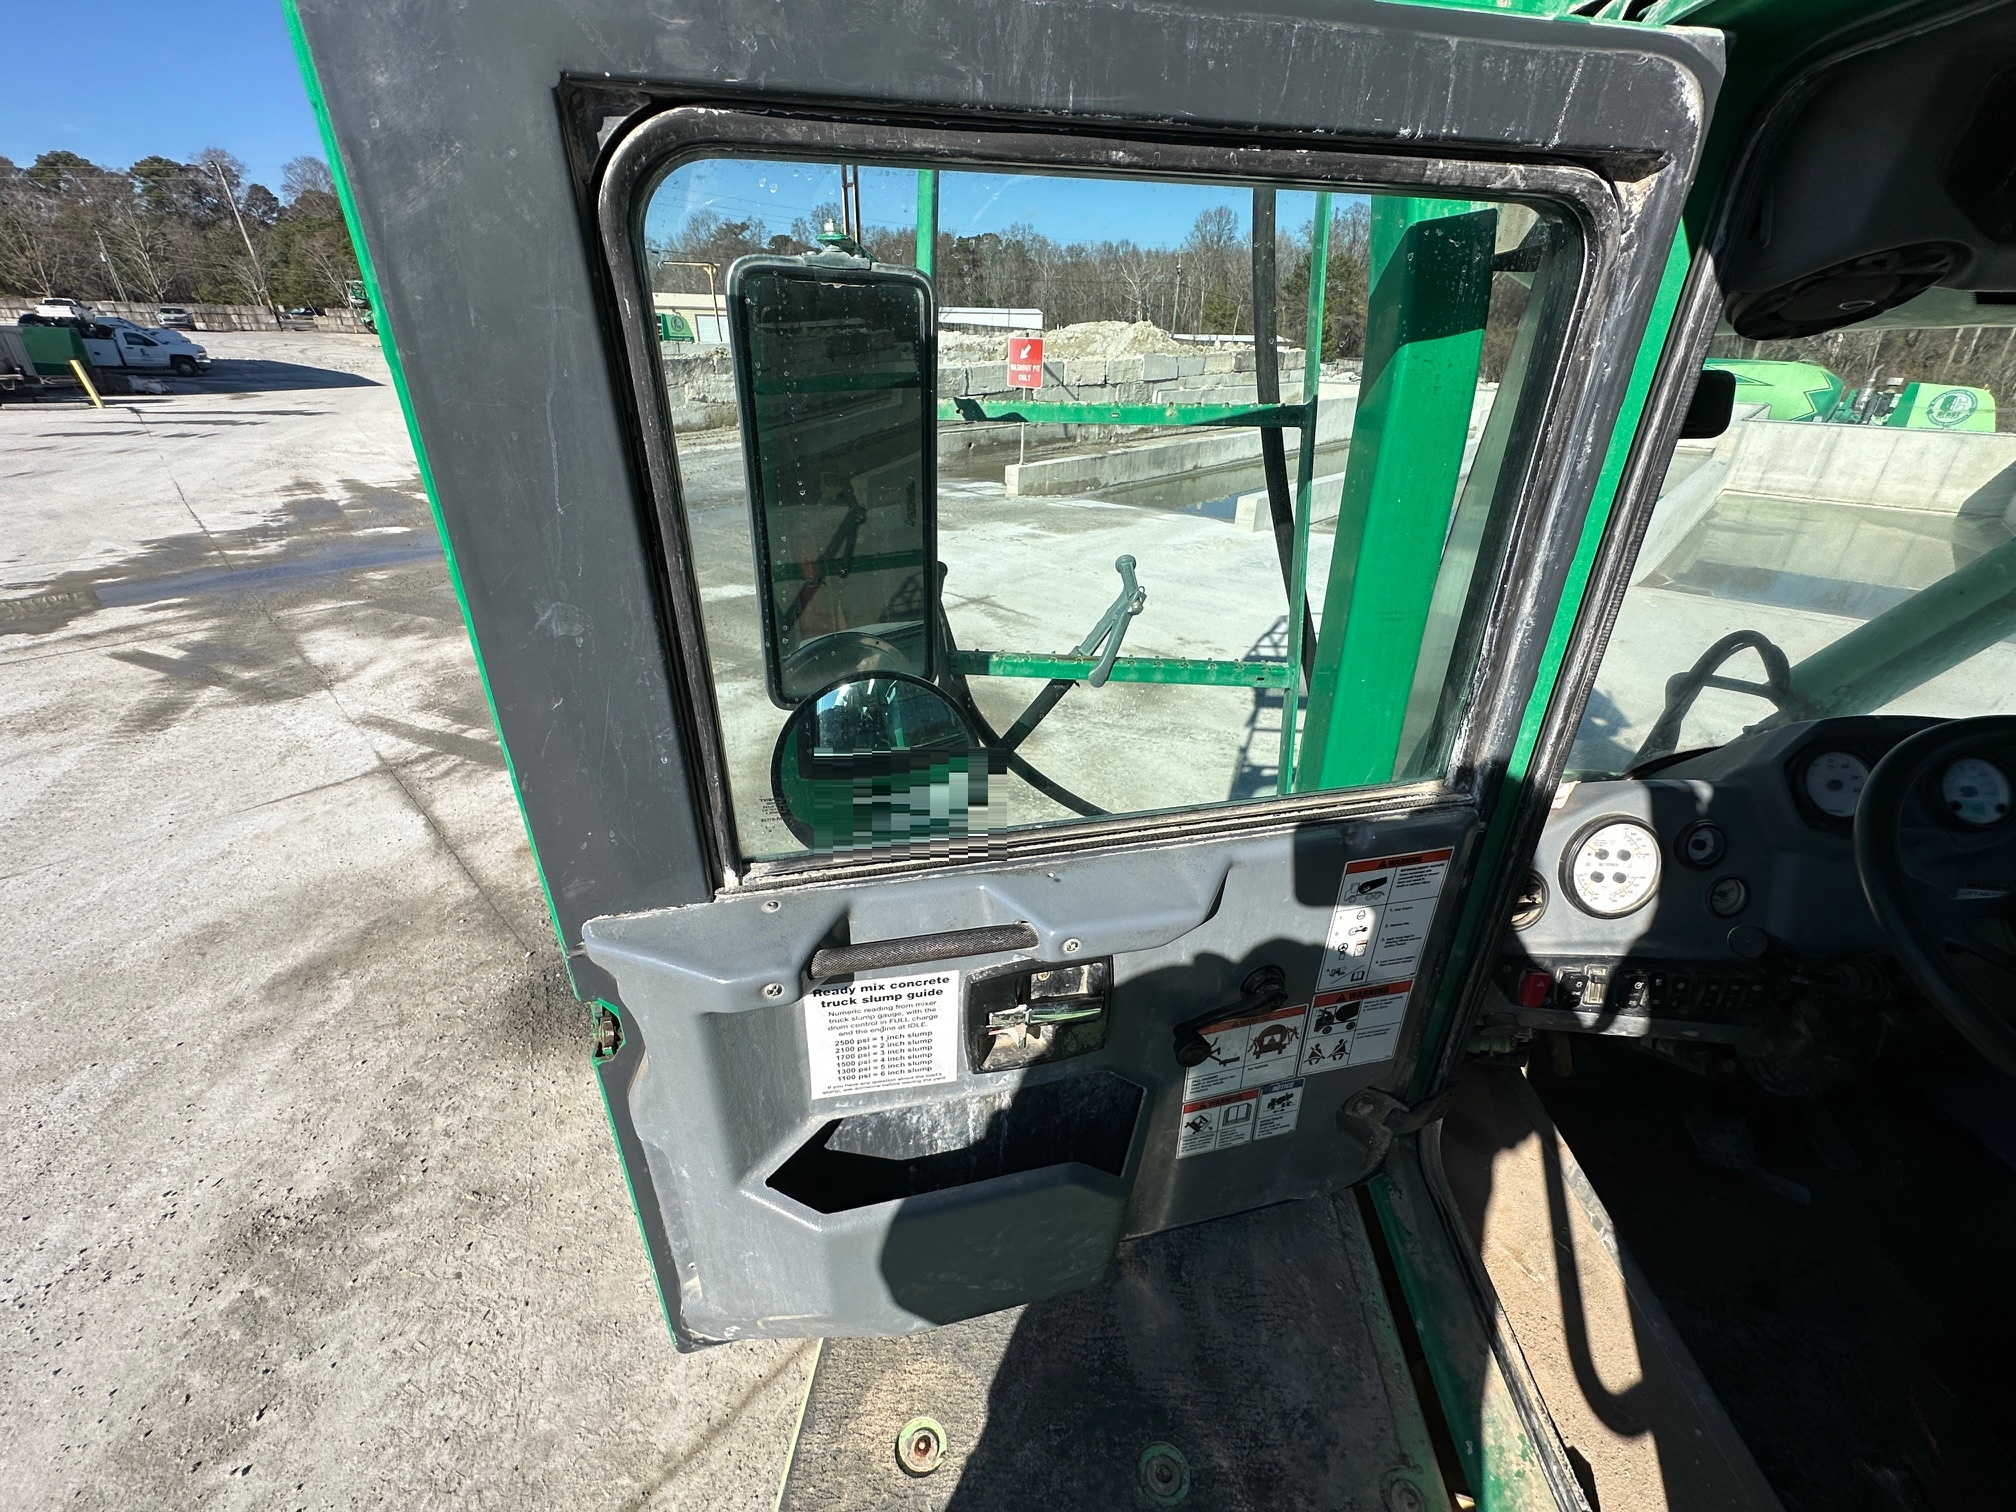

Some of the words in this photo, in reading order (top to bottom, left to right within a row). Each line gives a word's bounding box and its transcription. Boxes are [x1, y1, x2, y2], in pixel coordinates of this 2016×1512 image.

[1010, 363, 1032, 372] WASHOUT
[1032, 364, 1041, 372] PIT
[1018, 374, 1031, 382] ONLY
[1388, 856, 1423, 868] WARNING
[812, 986, 856, 997] Ready
[860, 983, 885, 992] mix
[890, 976, 950, 989] concrete
[1348, 986, 1389, 999] WARNING
[821, 997, 857, 1008] truck
[862, 994, 902, 1004] slump
[907, 988, 943, 1000] guide
[828, 1008, 862, 1016] Numeric
[835, 1038, 854, 1046] 2500
[857, 1037, 870, 1045] psi
[1208, 1094, 1242, 1107] WARNING
